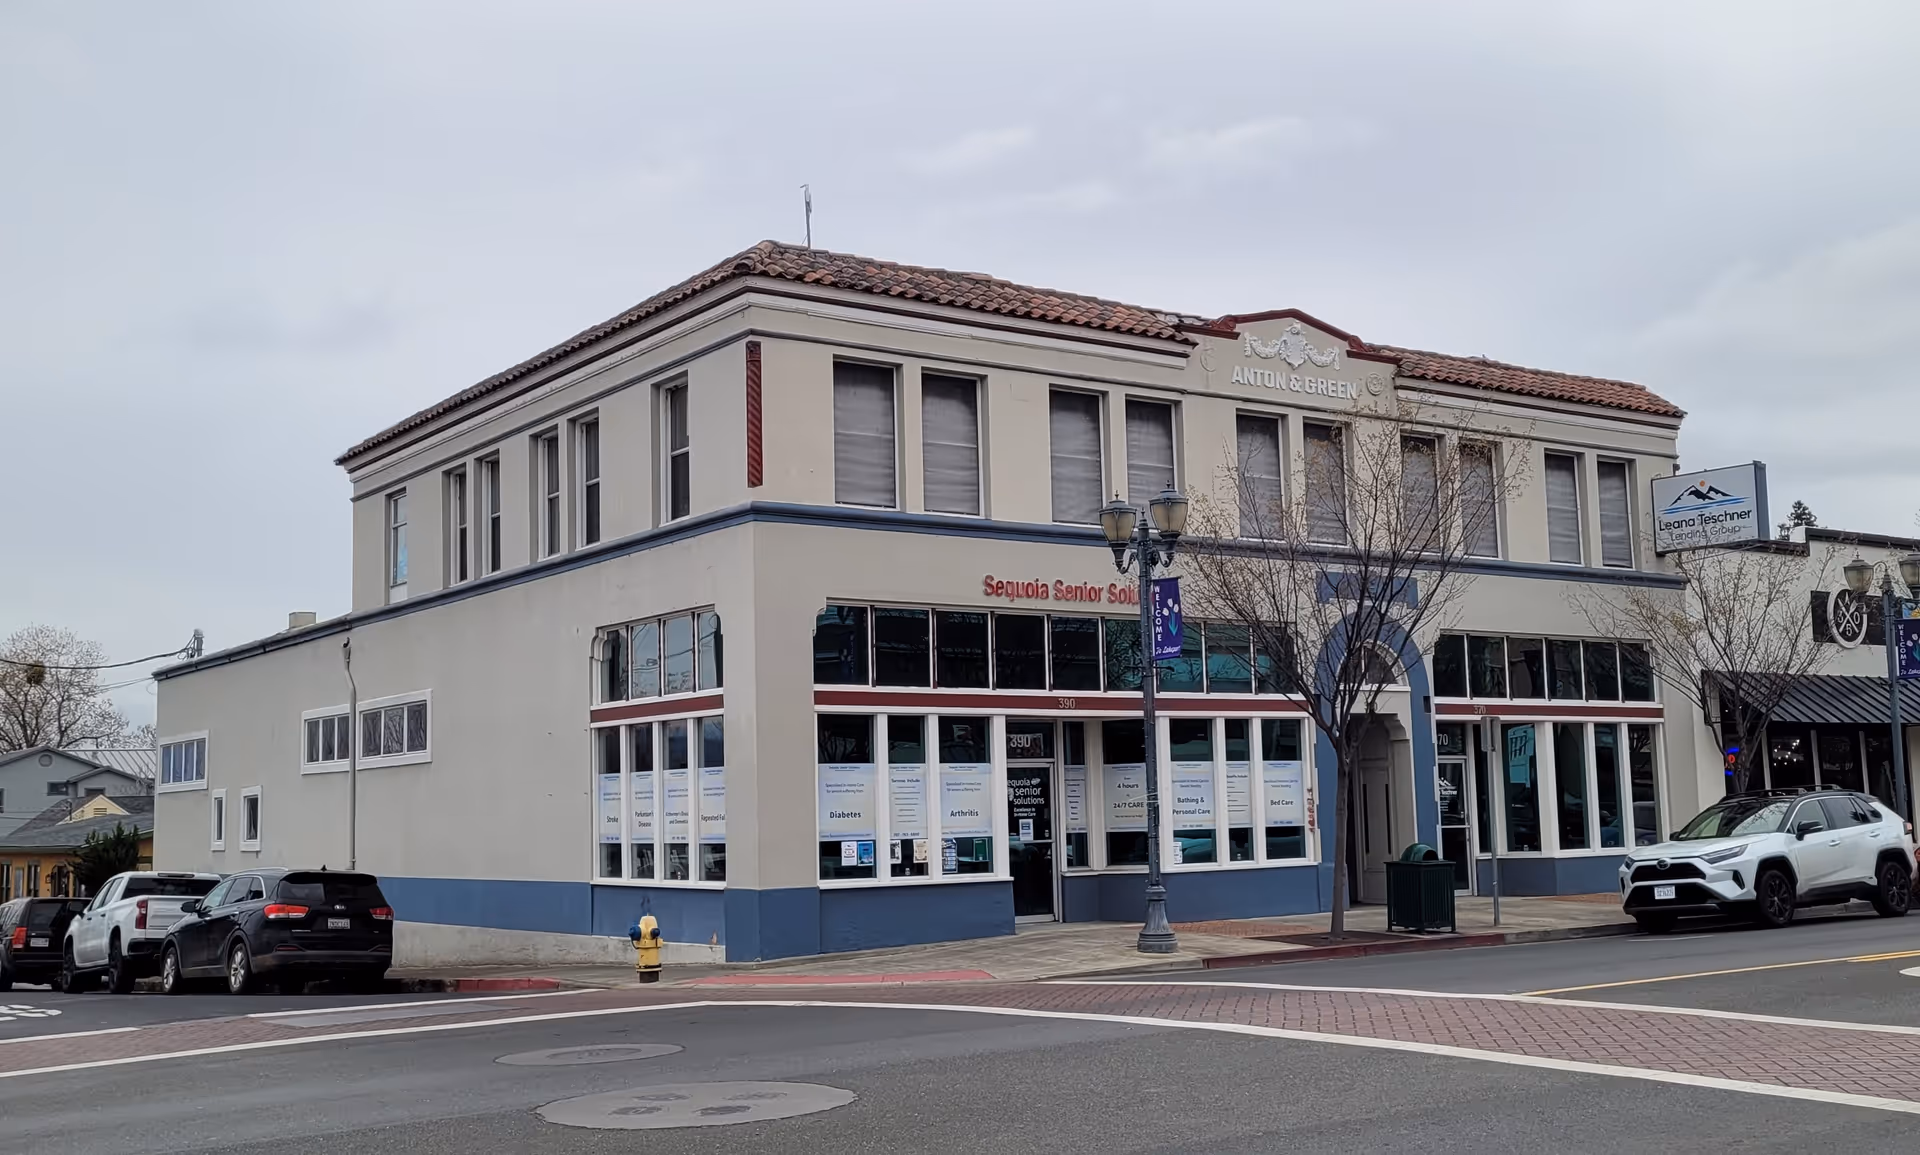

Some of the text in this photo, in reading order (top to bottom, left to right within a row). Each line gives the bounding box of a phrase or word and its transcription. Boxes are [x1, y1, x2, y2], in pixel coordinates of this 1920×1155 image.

[1231, 365, 1357, 400] ANTON & GREEN
[1658, 509, 1753, 531] Leana Teschner
[1670, 525, 1741, 541] Lending Group
[983, 575, 1049, 601] Sequoia
[1053, 579, 1104, 601] Senior
[1154, 585, 1163, 641] WELCOME
[1898, 624, 1907, 666] WELCOME
[1058, 698, 1076, 709] 390
[1473, 705, 1486, 714] 370
[1009, 734, 1031, 748] 390
[1437, 733, 1449, 745] 70
[1007, 778, 1030, 788] equoia
[1014, 785, 1042, 796] senior
[1013, 796, 1045, 805] solutions
[606, 815, 619, 823] Stroke
[829, 811, 861, 819] Diabetes
[950, 809, 979, 818] Arthritis
